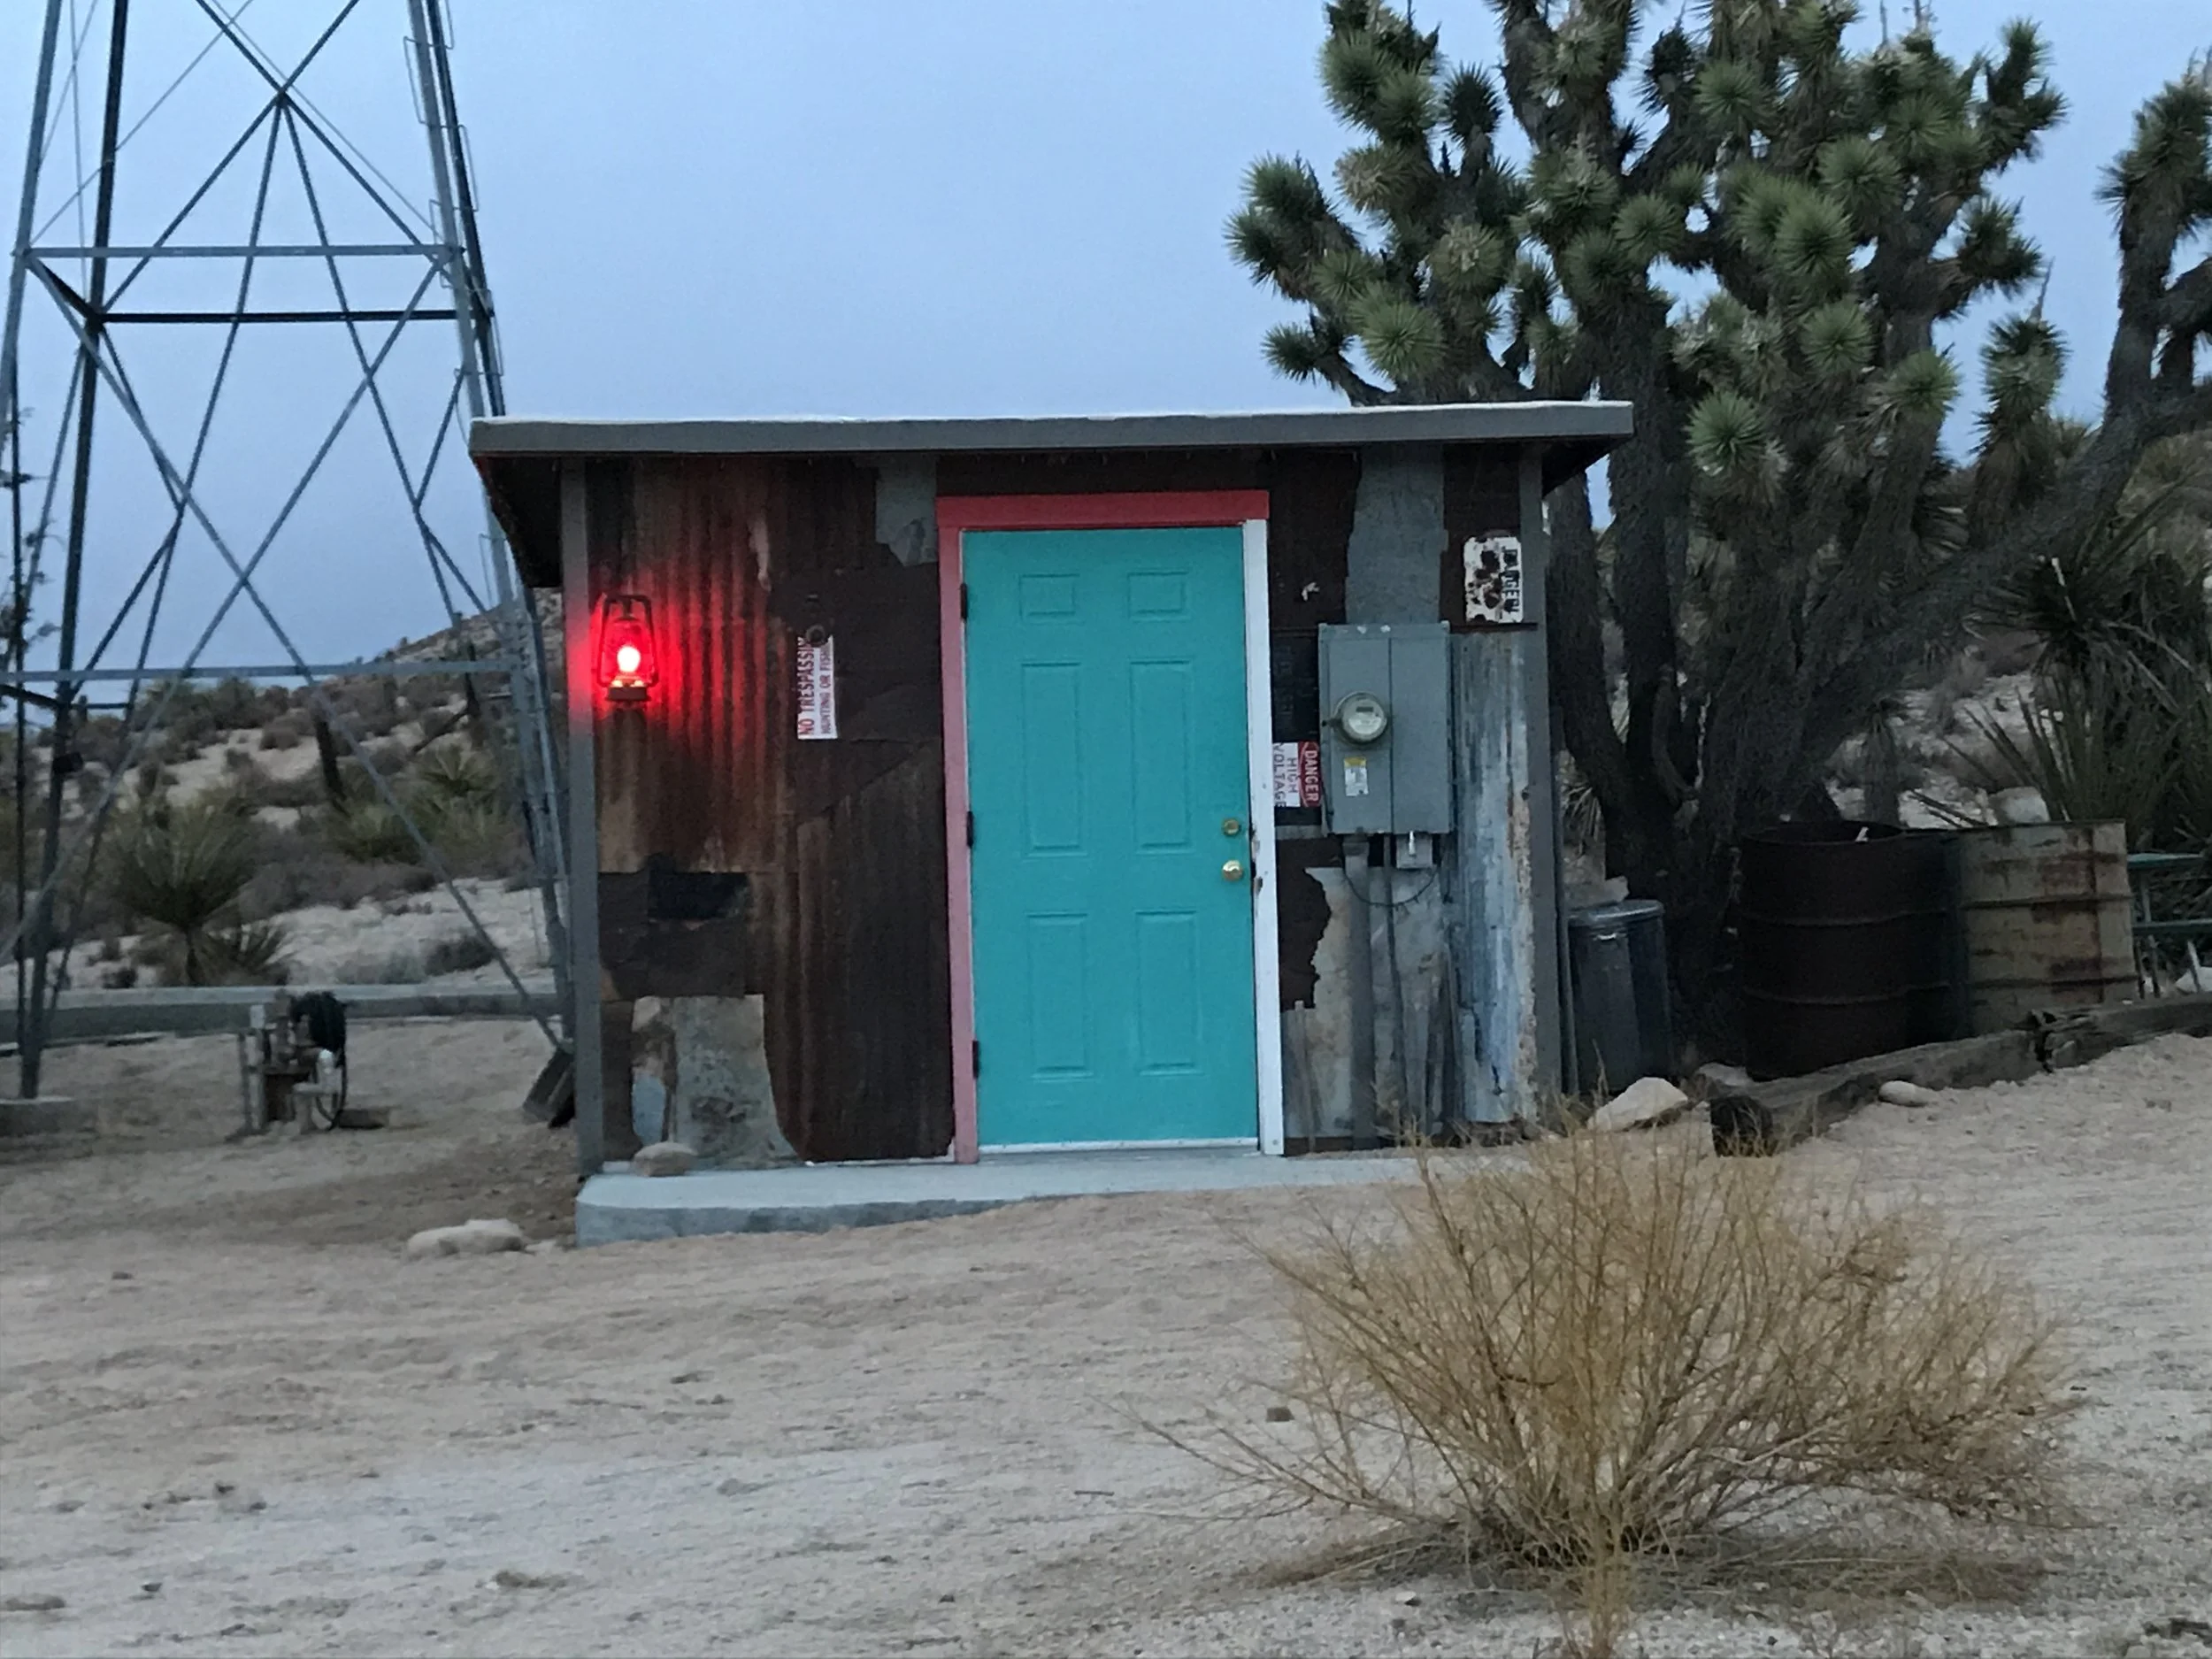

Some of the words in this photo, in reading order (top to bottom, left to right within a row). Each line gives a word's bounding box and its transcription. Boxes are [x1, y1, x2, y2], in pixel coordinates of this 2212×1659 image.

[819, 674, 832, 689] OR
[797, 718, 815, 735] NO
[819, 693, 832, 734] HUNTING
[1274, 743, 1286, 807] VOLTAGE
[1287, 757, 1299, 793] HIGH
[1304, 750, 1319, 802] DANGER
